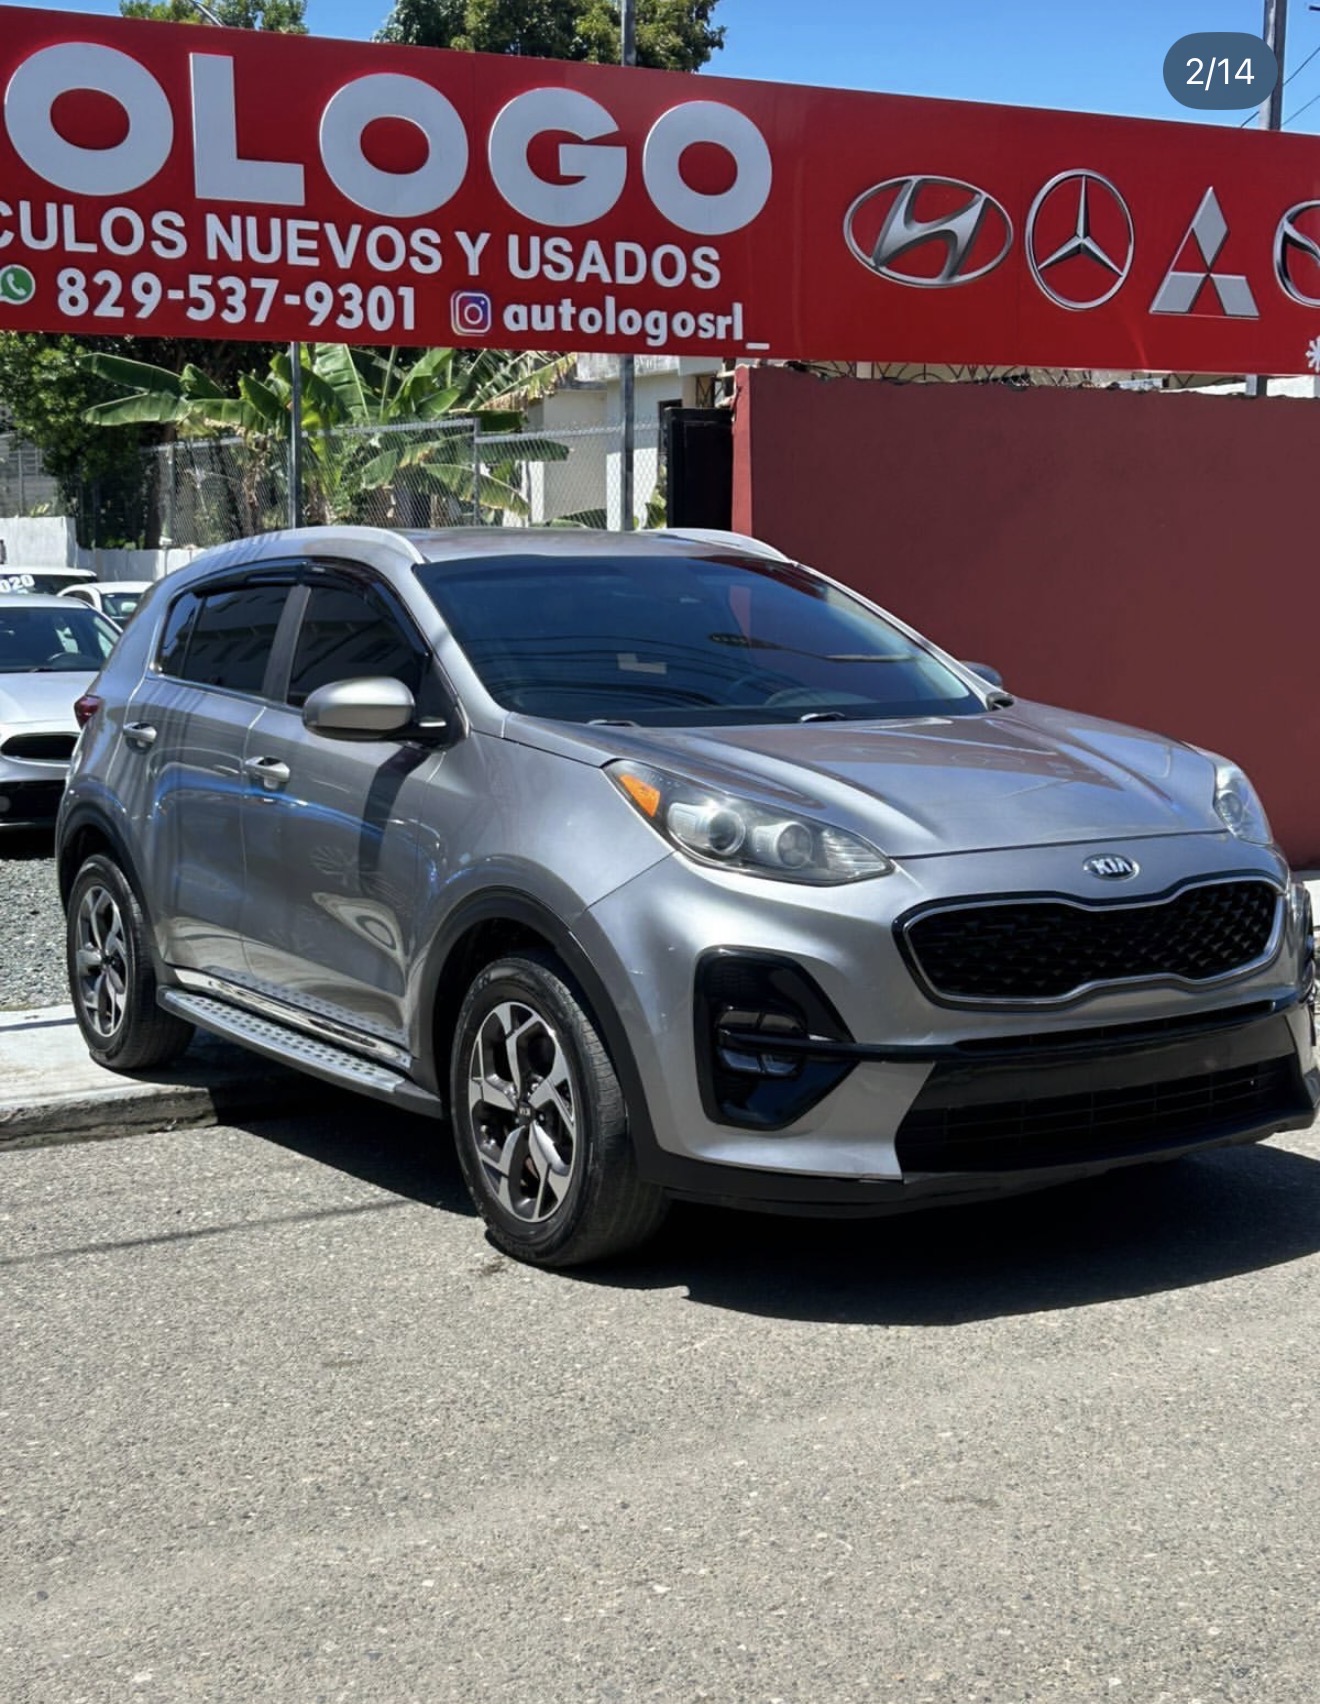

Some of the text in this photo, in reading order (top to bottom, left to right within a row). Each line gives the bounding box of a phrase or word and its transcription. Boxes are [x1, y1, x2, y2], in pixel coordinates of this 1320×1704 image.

[3, 41, 773, 236] OLOGO
[205, 213, 443, 275] NUEVOS
[454, 231, 491, 276] Y
[508, 234, 721, 289] USADOS
[57, 267, 770, 350] 829-537-9301 autologosrl_
[1091, 857, 1133, 875] KIA
